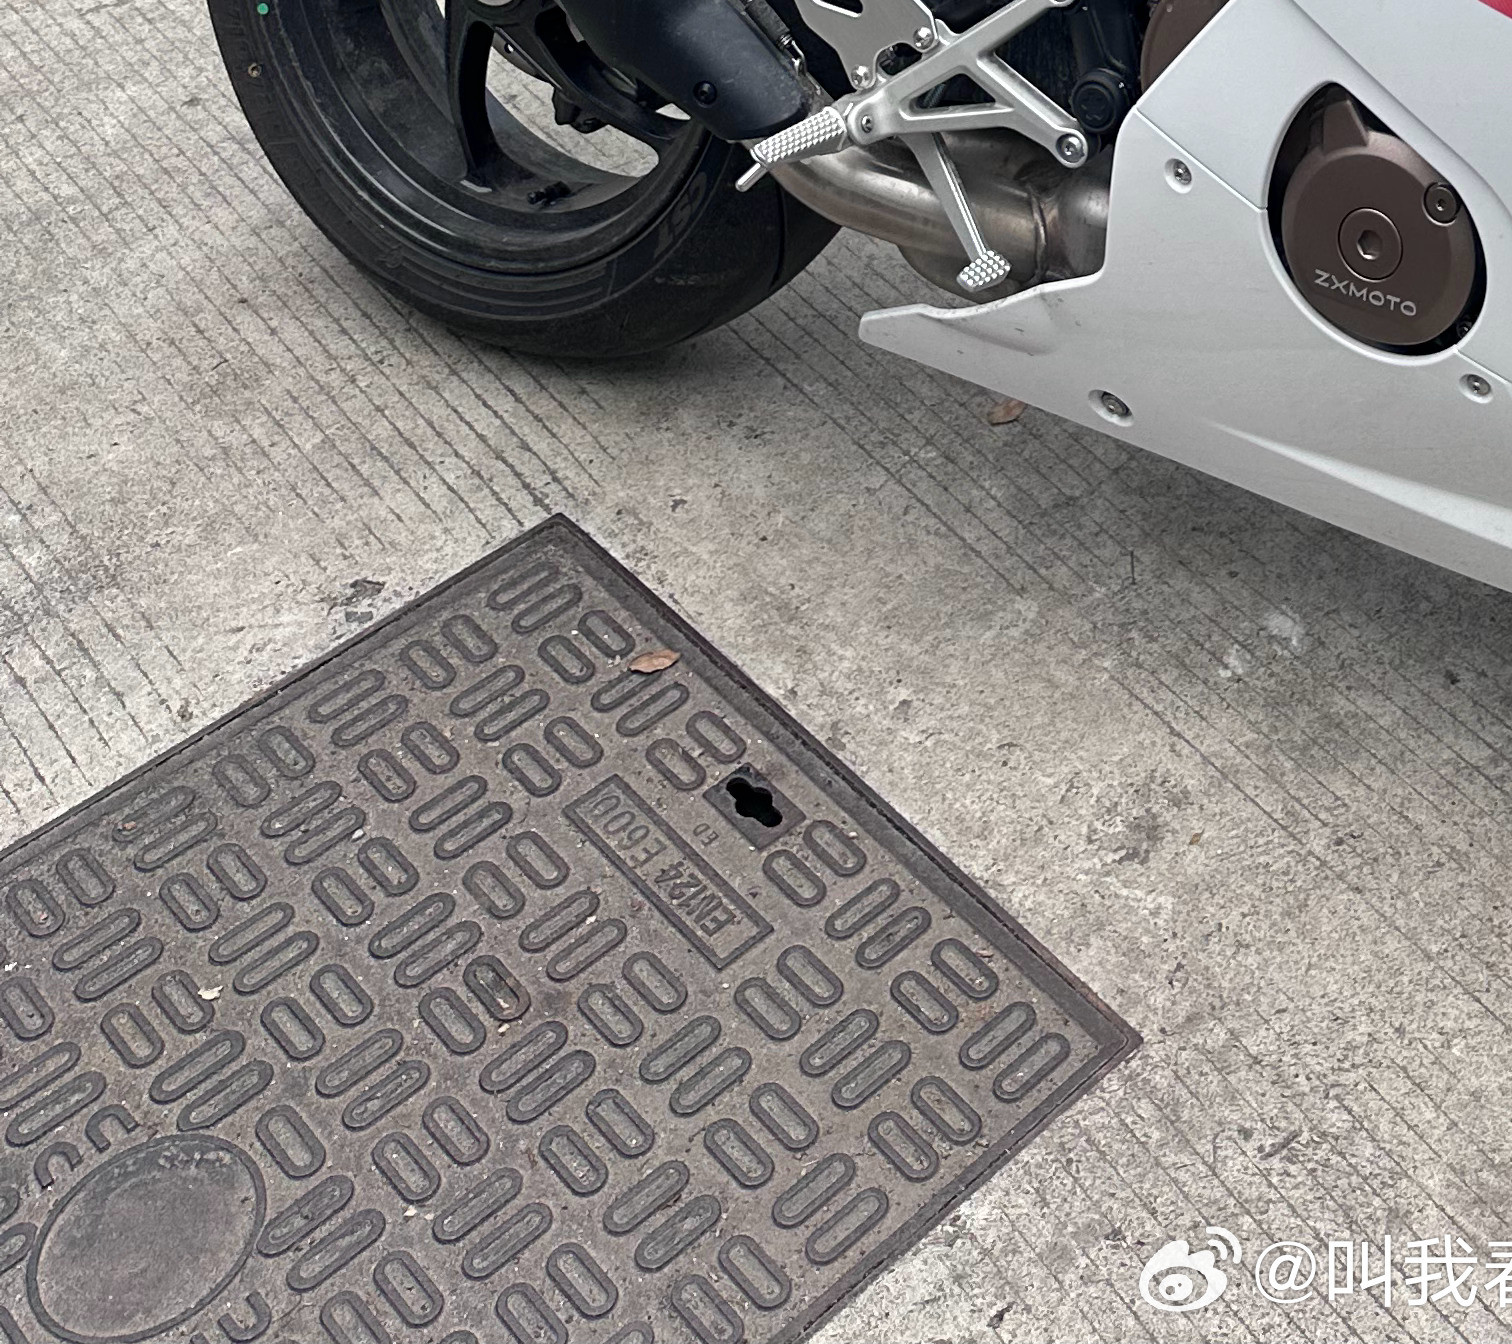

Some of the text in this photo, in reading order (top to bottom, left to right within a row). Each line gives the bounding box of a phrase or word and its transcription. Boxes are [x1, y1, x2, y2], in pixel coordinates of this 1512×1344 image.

[1314, 268, 1417, 316] ZXMOTO
[592, 794, 737, 938] EN124 E600
